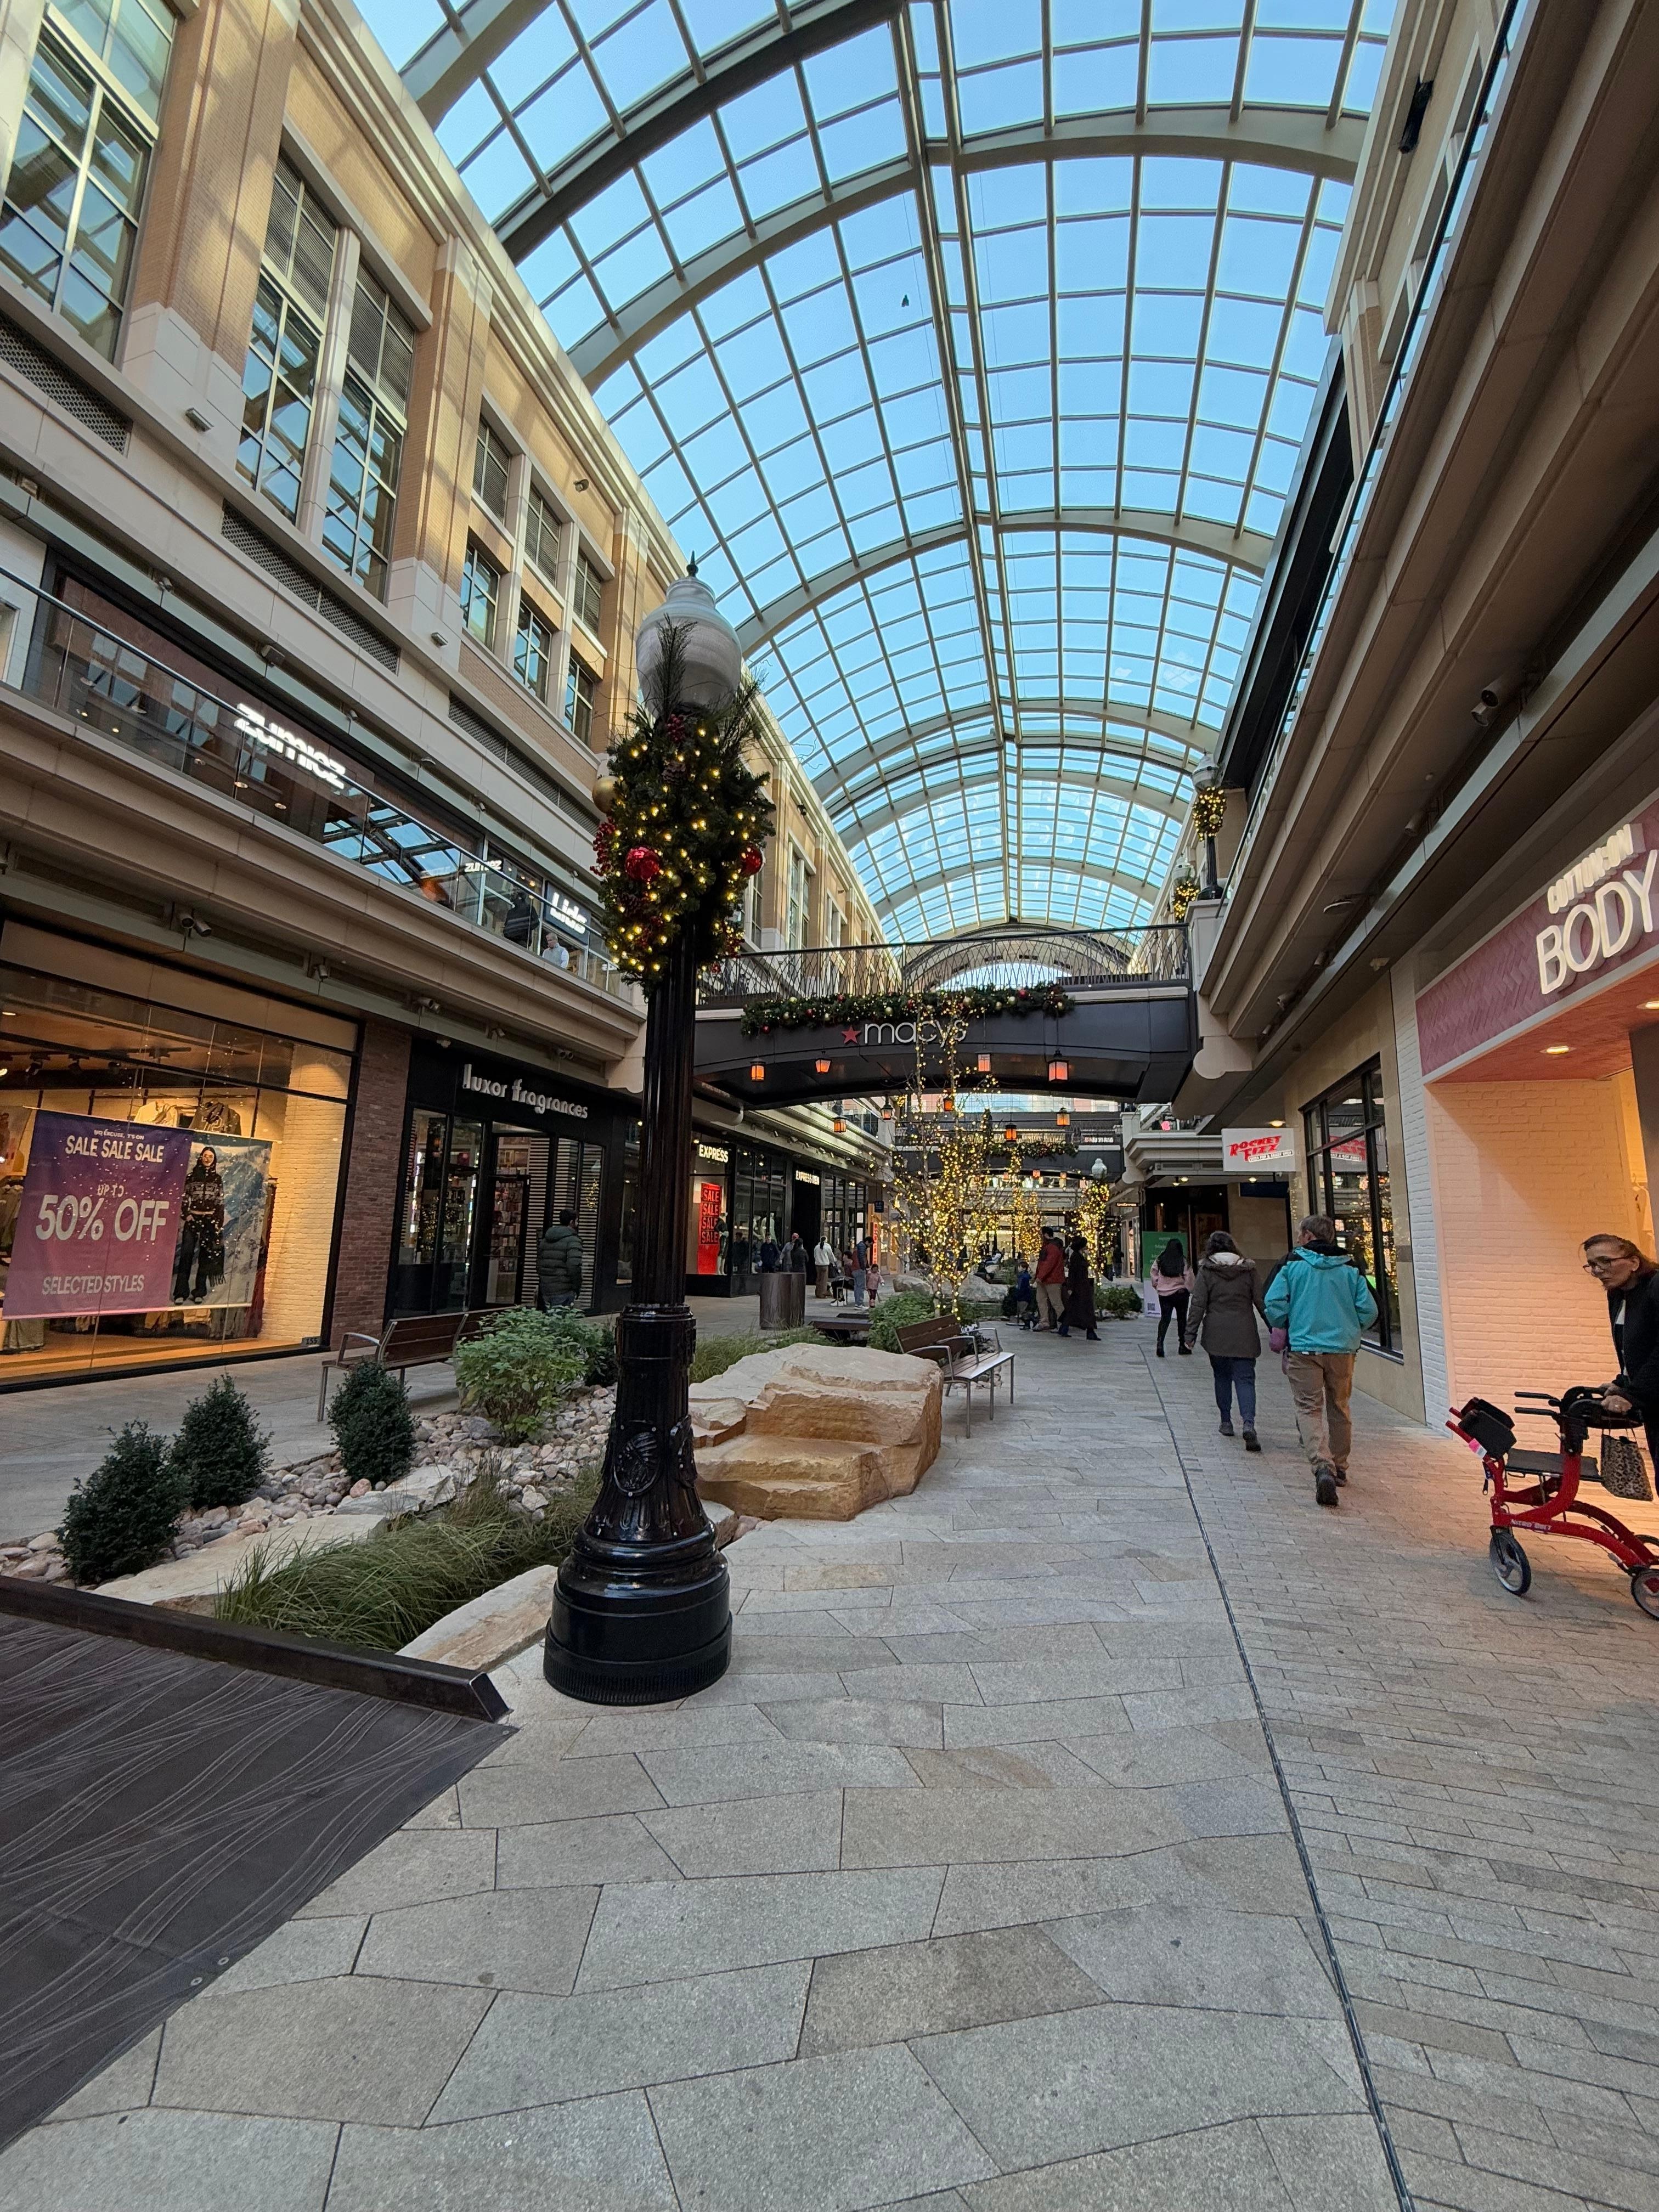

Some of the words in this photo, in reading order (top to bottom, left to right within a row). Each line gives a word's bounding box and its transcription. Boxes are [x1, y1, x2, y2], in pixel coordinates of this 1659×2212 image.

[464, 860, 502, 872] zumez
[550, 892, 587, 935] Lids
[1536, 849, 1658, 995] BODY
[462, 1064, 507, 1097] luxor
[512, 1079, 588, 1119] fragrances
[65, 1135, 99, 1157] SALE
[101, 1139, 133, 1160] SALE
[135, 1143, 165, 1163] SALE
[698, 1144, 729, 1163] EXPRESS
[795, 1170, 812, 1183] EXPRESS
[97, 1184, 110, 1196] UP
[703, 1189, 719, 1202] SALE
[703, 1203, 719, 1215] SALE
[36, 1194, 105, 1241] 50%
[115, 1198, 170, 1242] OFF
[702, 1216, 719, 1229] SALE
[702, 1231, 719, 1243] SALE
[42, 1276, 103, 1295] SELECTED
[104, 1274, 145, 1293] STYLES
